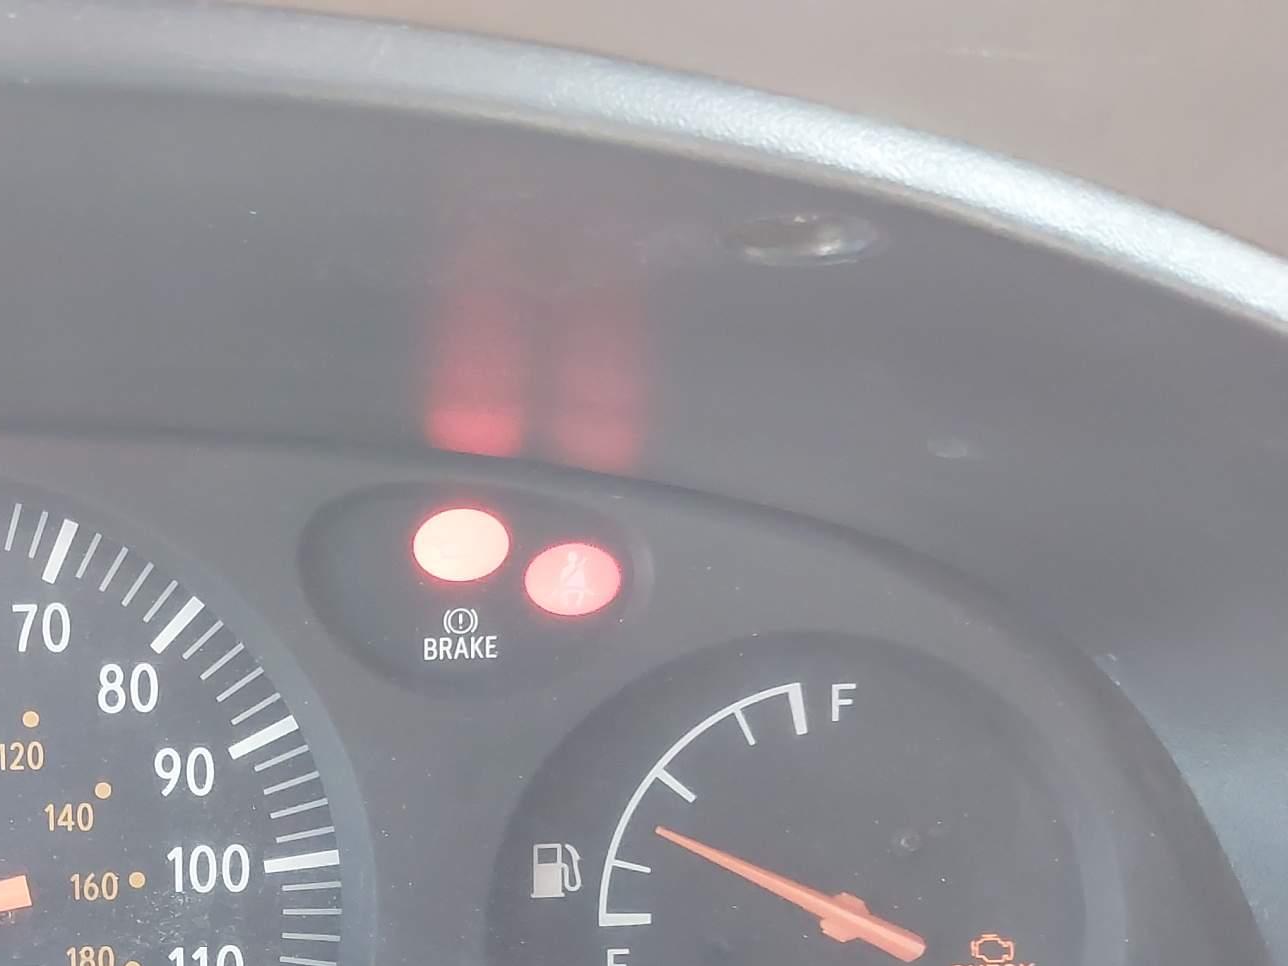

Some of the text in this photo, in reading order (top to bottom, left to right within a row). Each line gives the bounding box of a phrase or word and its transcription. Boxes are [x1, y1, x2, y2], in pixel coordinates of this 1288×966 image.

[12, 603, 70, 652] 70
[424, 636, 497, 660] BRAKE
[98, 663, 158, 713] 80
[832, 684, 856, 721] F
[155, 747, 214, 796] 90
[45, 803, 93, 831] 140
[71, 873, 118, 900] 160
[167, 844, 249, 893] 100
